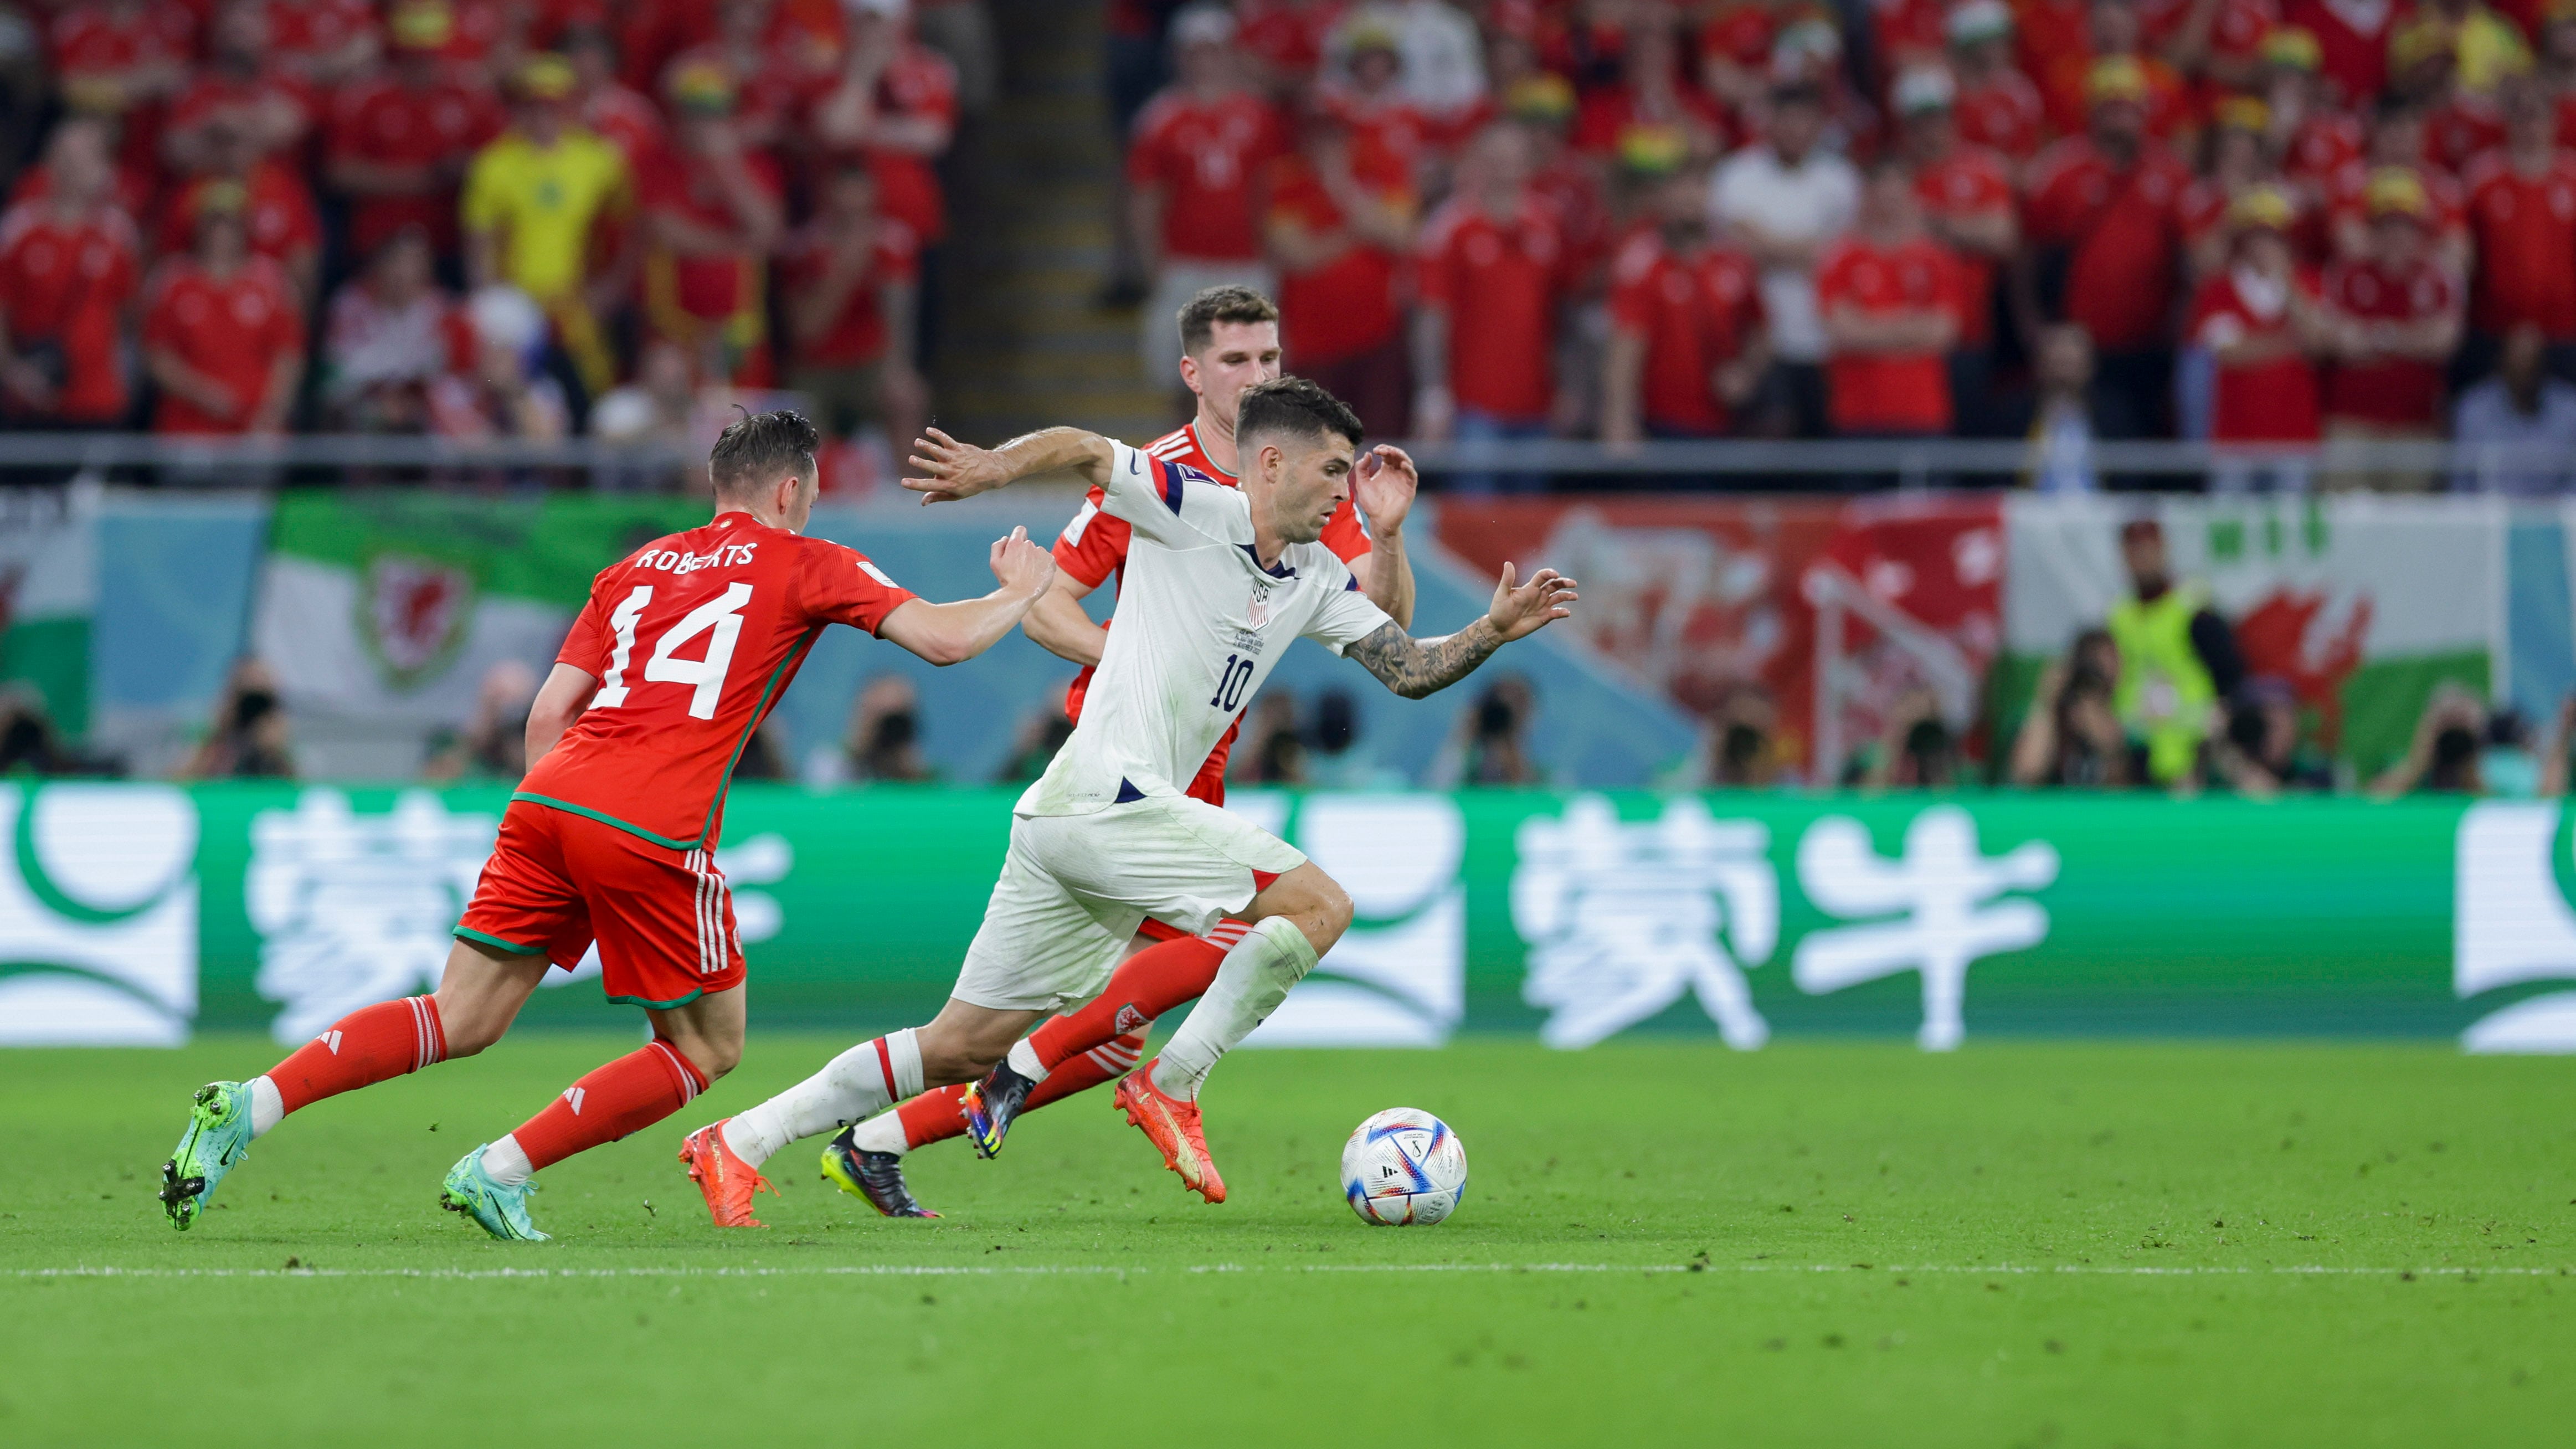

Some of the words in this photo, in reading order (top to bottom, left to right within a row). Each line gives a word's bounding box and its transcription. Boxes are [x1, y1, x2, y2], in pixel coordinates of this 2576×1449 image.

[635, 542, 758, 574] ROBERTS
[1252, 579, 1269, 603] USA
[588, 582, 754, 720] 14
[1210, 654, 1254, 713] 10
[1513, 797, 2056, 1050] 蒙牛
